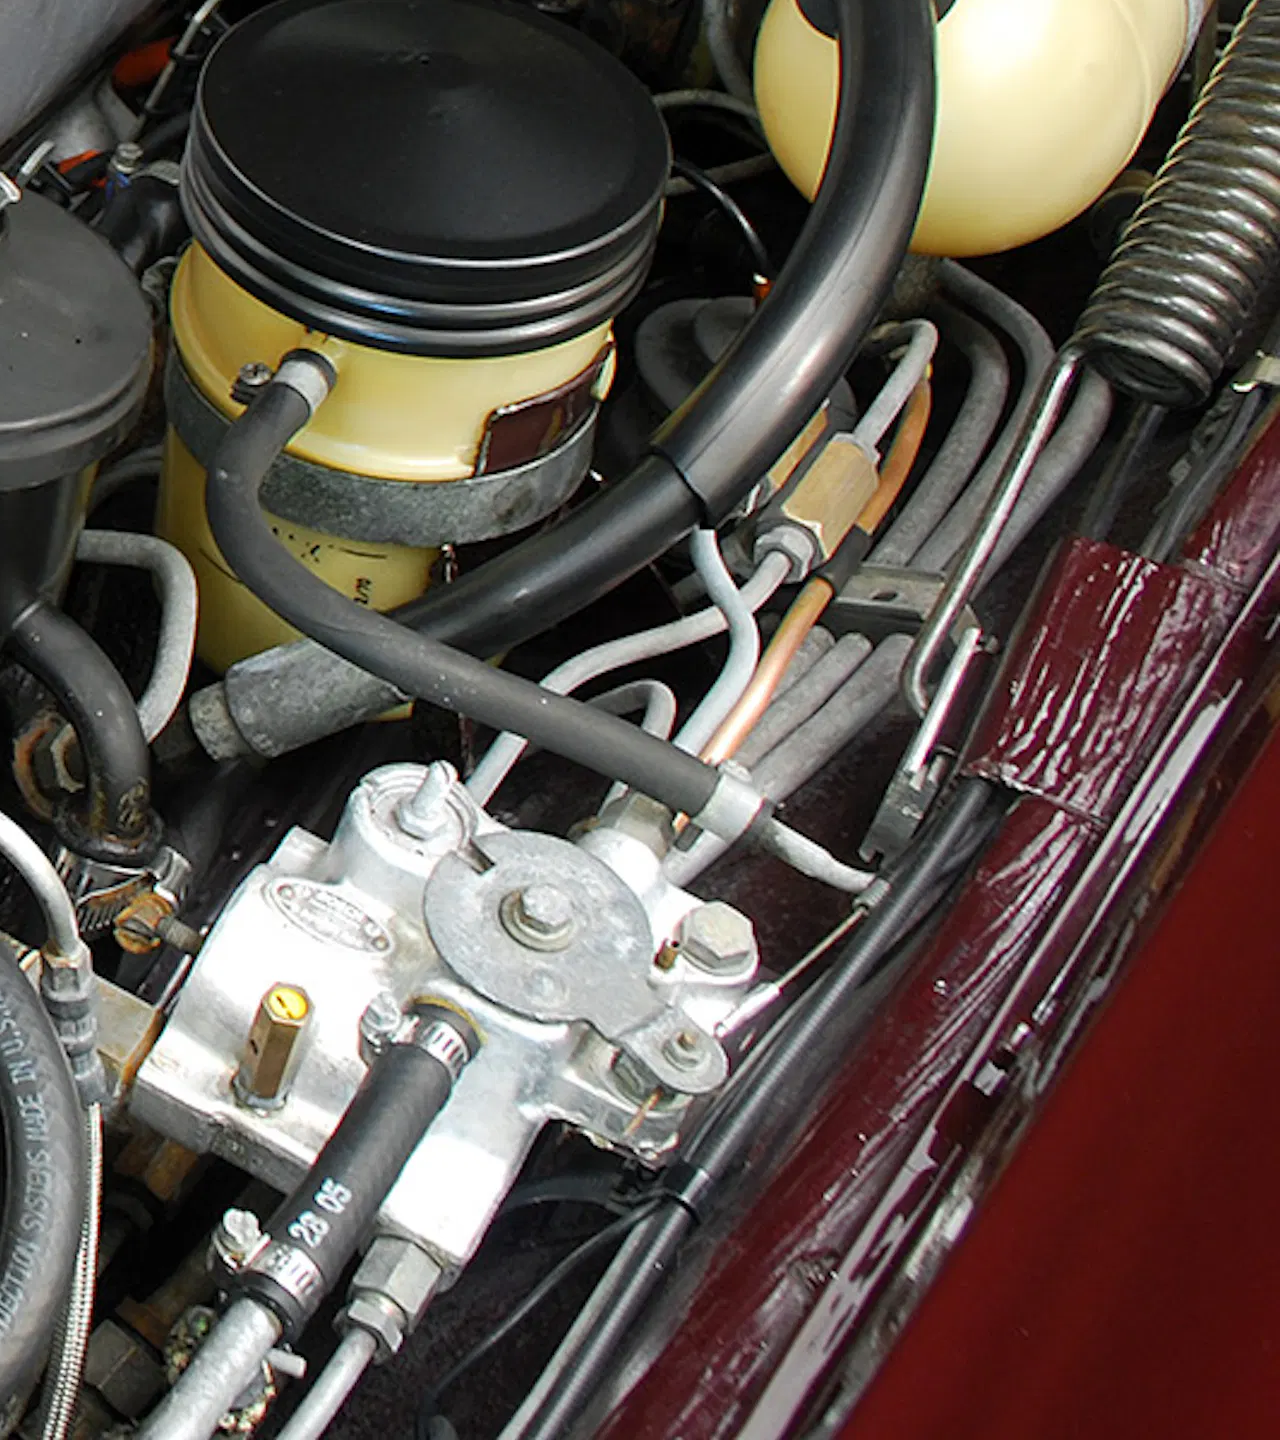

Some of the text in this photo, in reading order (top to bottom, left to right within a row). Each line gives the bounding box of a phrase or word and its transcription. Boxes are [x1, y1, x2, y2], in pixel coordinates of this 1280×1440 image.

[7, 1059, 37, 1085] IN
[17, 1092, 50, 1143] MADE
[315, 1177, 352, 1214] 05
